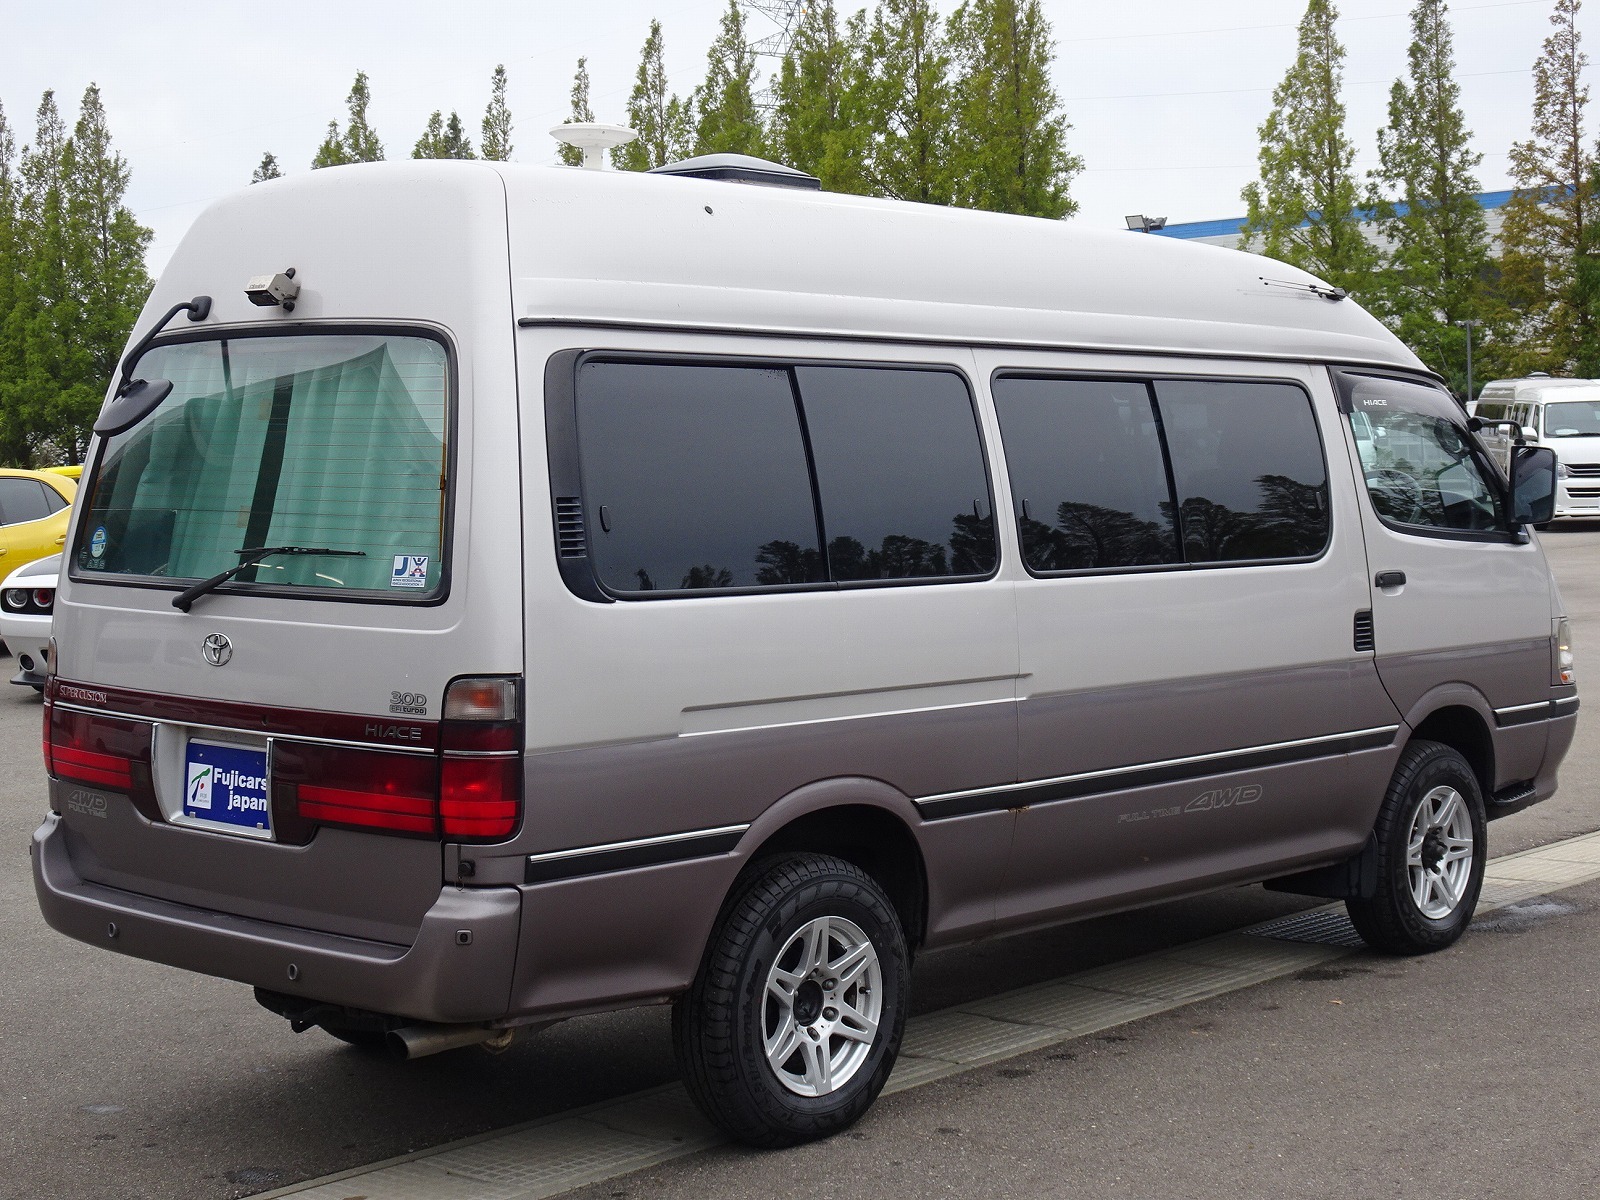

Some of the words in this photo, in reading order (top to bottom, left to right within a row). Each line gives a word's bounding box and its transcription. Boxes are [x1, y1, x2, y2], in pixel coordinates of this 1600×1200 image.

[59, 685, 79, 698] SUPER
[79, 688, 107, 704] CUSTOM
[402, 706, 424, 714] turbo
[365, 724, 422, 741] HIACE
[213, 767, 267, 790] Fujicars
[69, 790, 108, 809] 4WD
[227, 791, 267, 812] japan
[1117, 811, 1150, 824] FULL
[1151, 806, 1181, 819] TIME
[1184, 784, 1263, 813] 4WD
[68, 804, 88, 815] FULL
[88, 807, 107, 819] TIME
